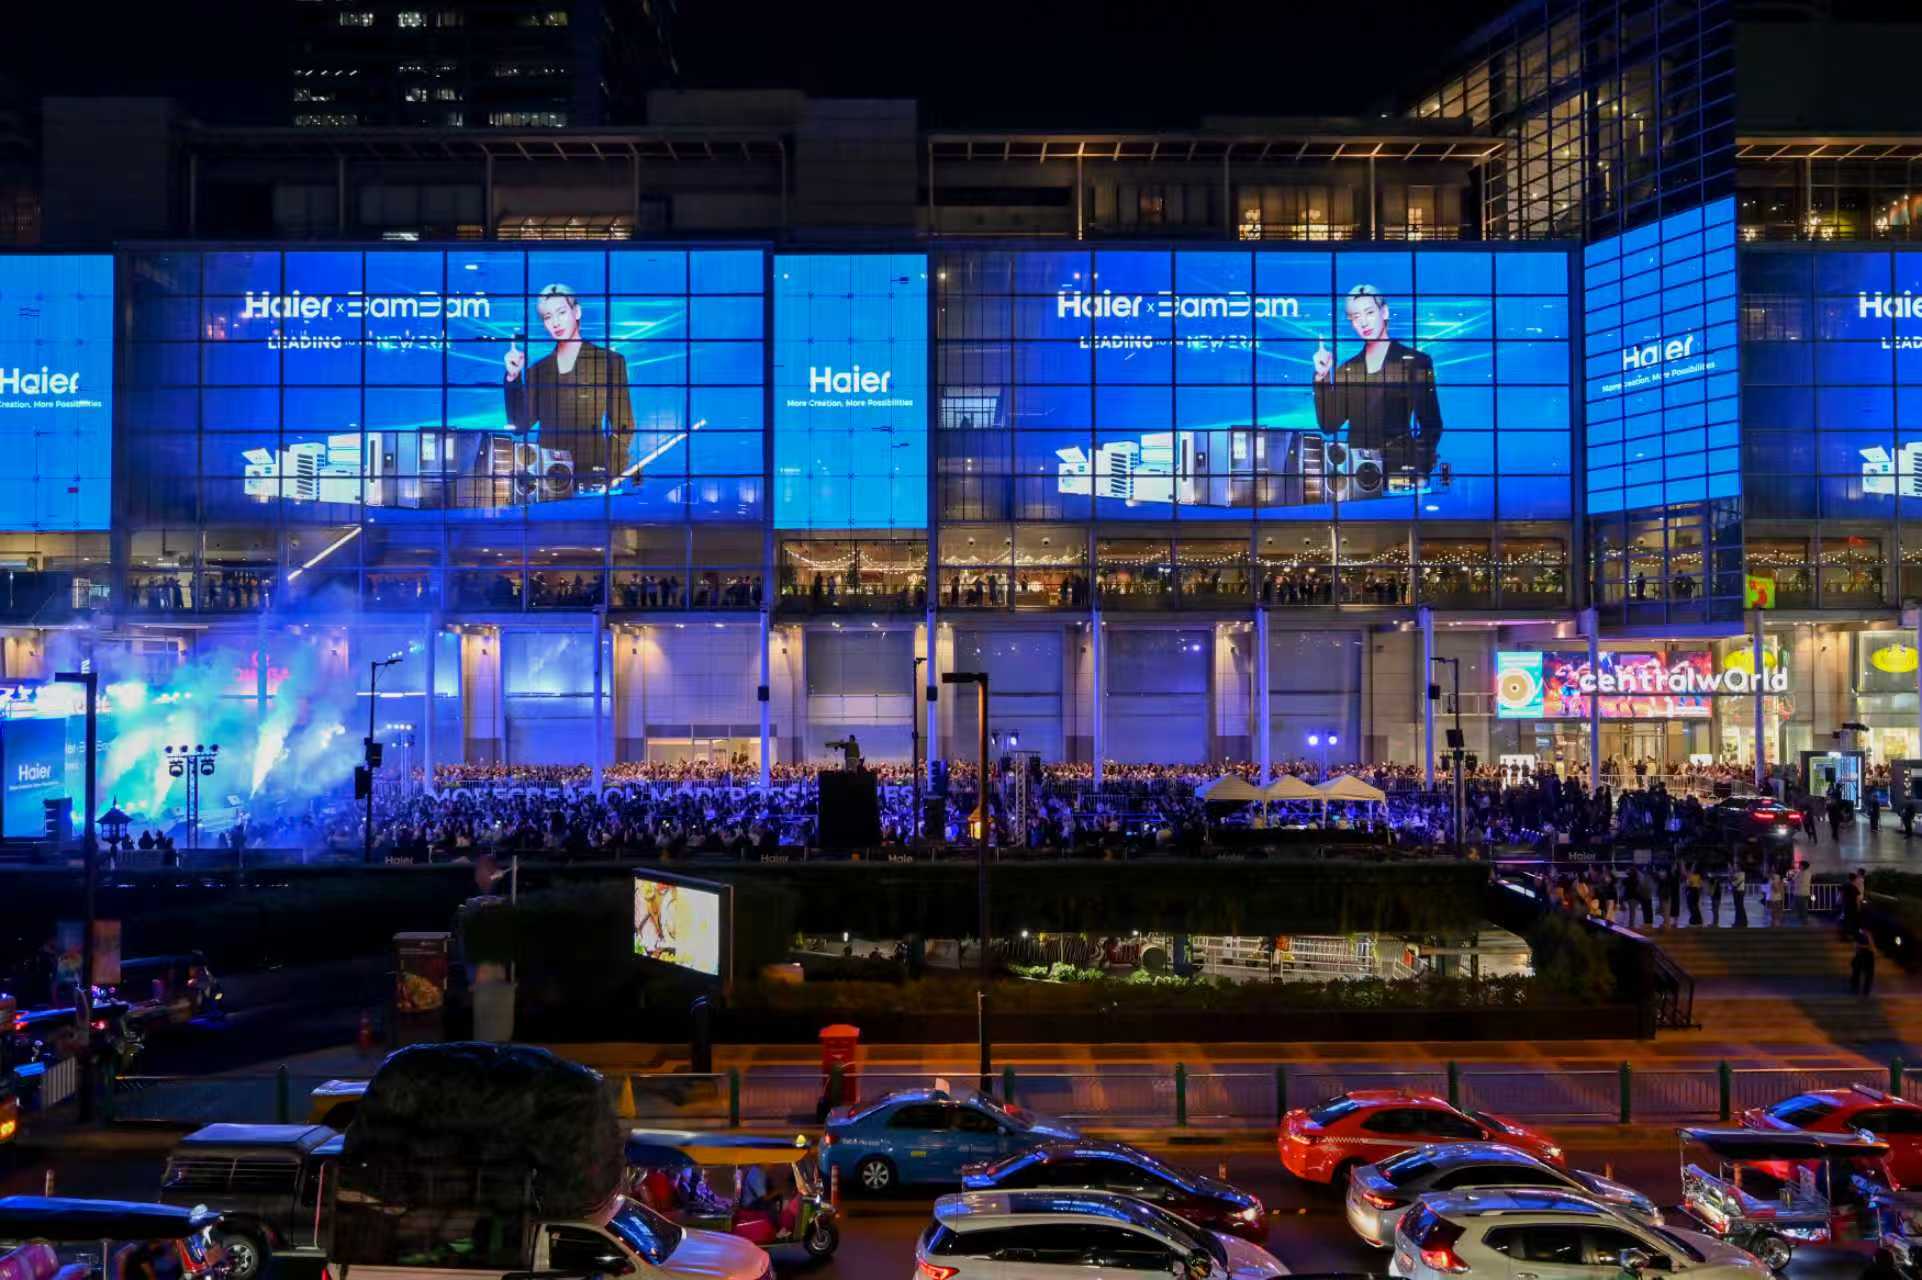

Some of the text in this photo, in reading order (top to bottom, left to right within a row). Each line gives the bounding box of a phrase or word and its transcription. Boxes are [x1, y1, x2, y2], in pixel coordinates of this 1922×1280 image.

[245, 290, 332, 318] Haier
[1058, 289, 1143, 318] Haier
[1622, 335, 1694, 371] Haier
[809, 364, 892, 394] Haier
[18, 762, 52, 782] Haier
